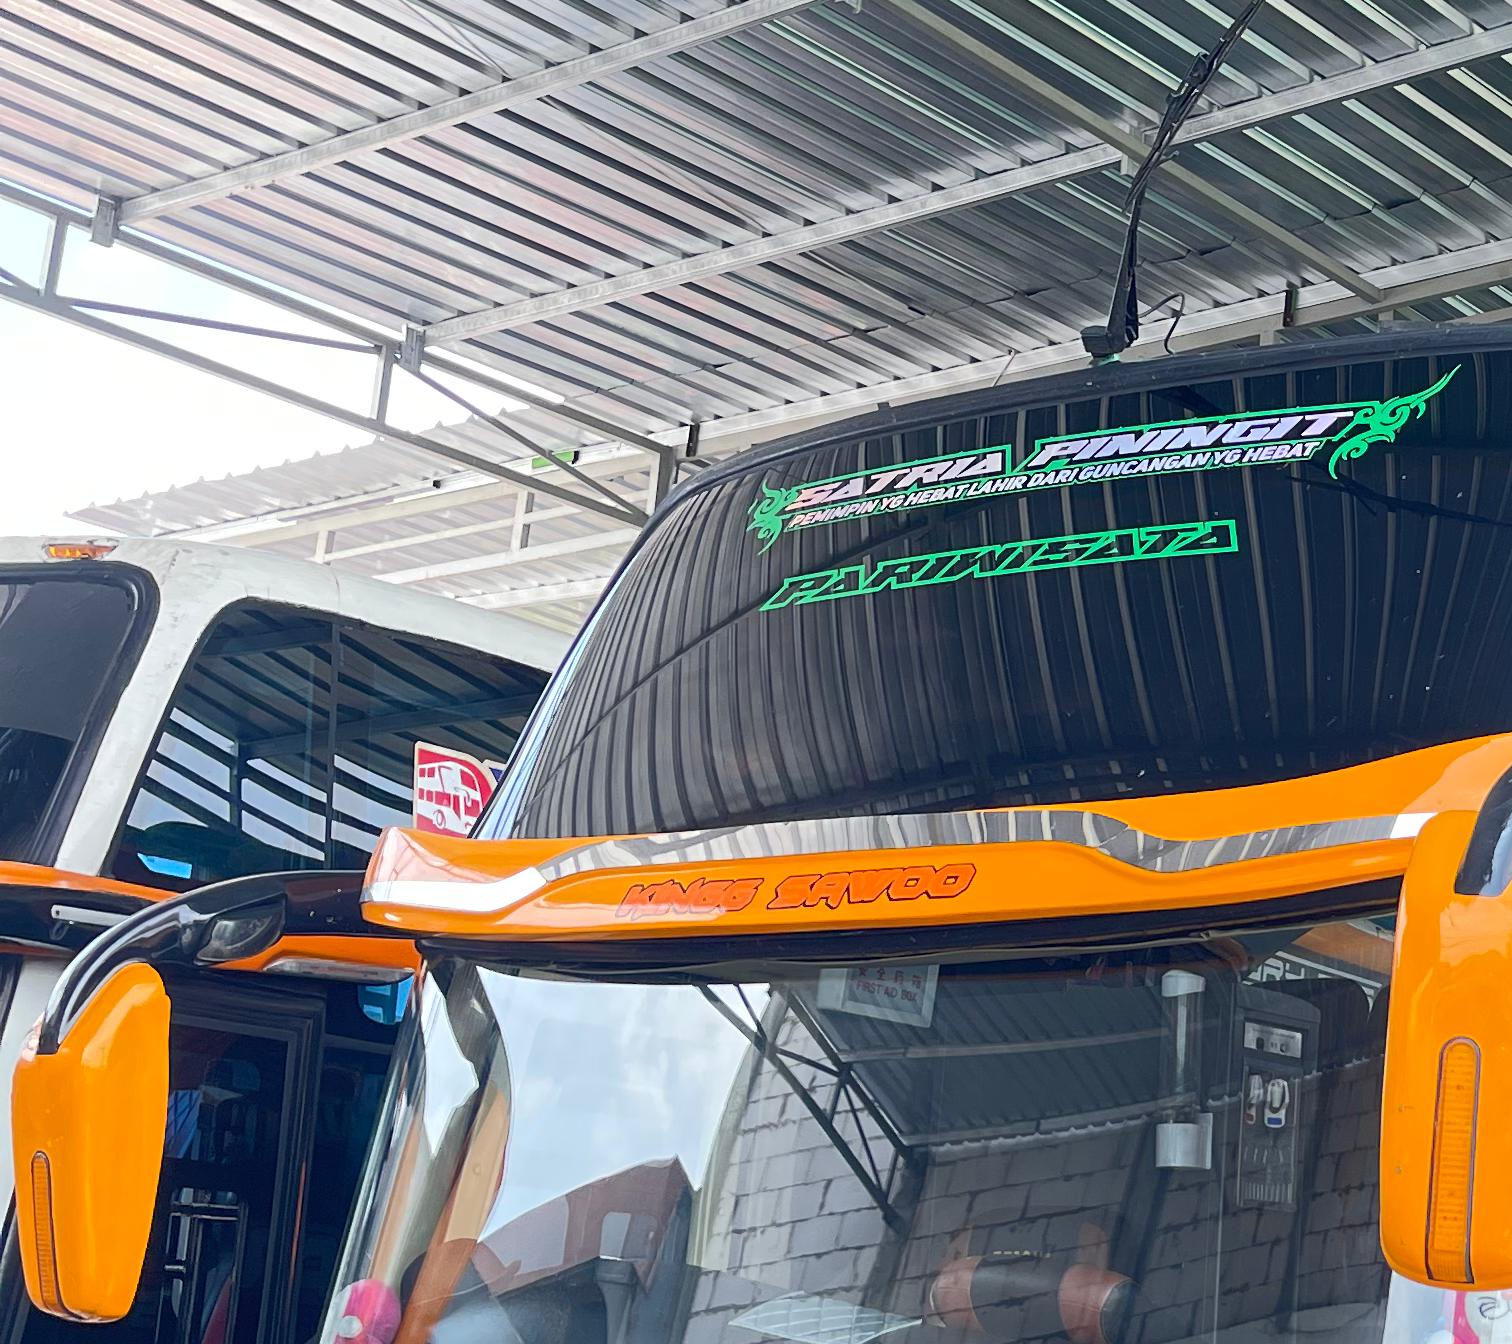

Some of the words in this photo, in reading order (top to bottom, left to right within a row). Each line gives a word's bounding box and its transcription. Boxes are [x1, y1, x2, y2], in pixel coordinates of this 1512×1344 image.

[786, 452, 1003, 511] SATRIA
[1027, 410, 1354, 468] PININGIT
[788, 500, 882, 529] PEMIMPIN
[880, 494, 906, 512] YG
[903, 484, 970, 507] HEBAT
[966, 471, 1026, 497] LAHIR
[1026, 467, 1076, 489] DARI
[1078, 451, 1212, 481] GUNCANGAN
[1212, 449, 1245, 466] YG
[1245, 441, 1322, 464] HEBAT
[760, 519, 1239, 612] PARIWISATA
[767, 863, 977, 910] SAWOO
[855, 979, 883, 994] FIRST
